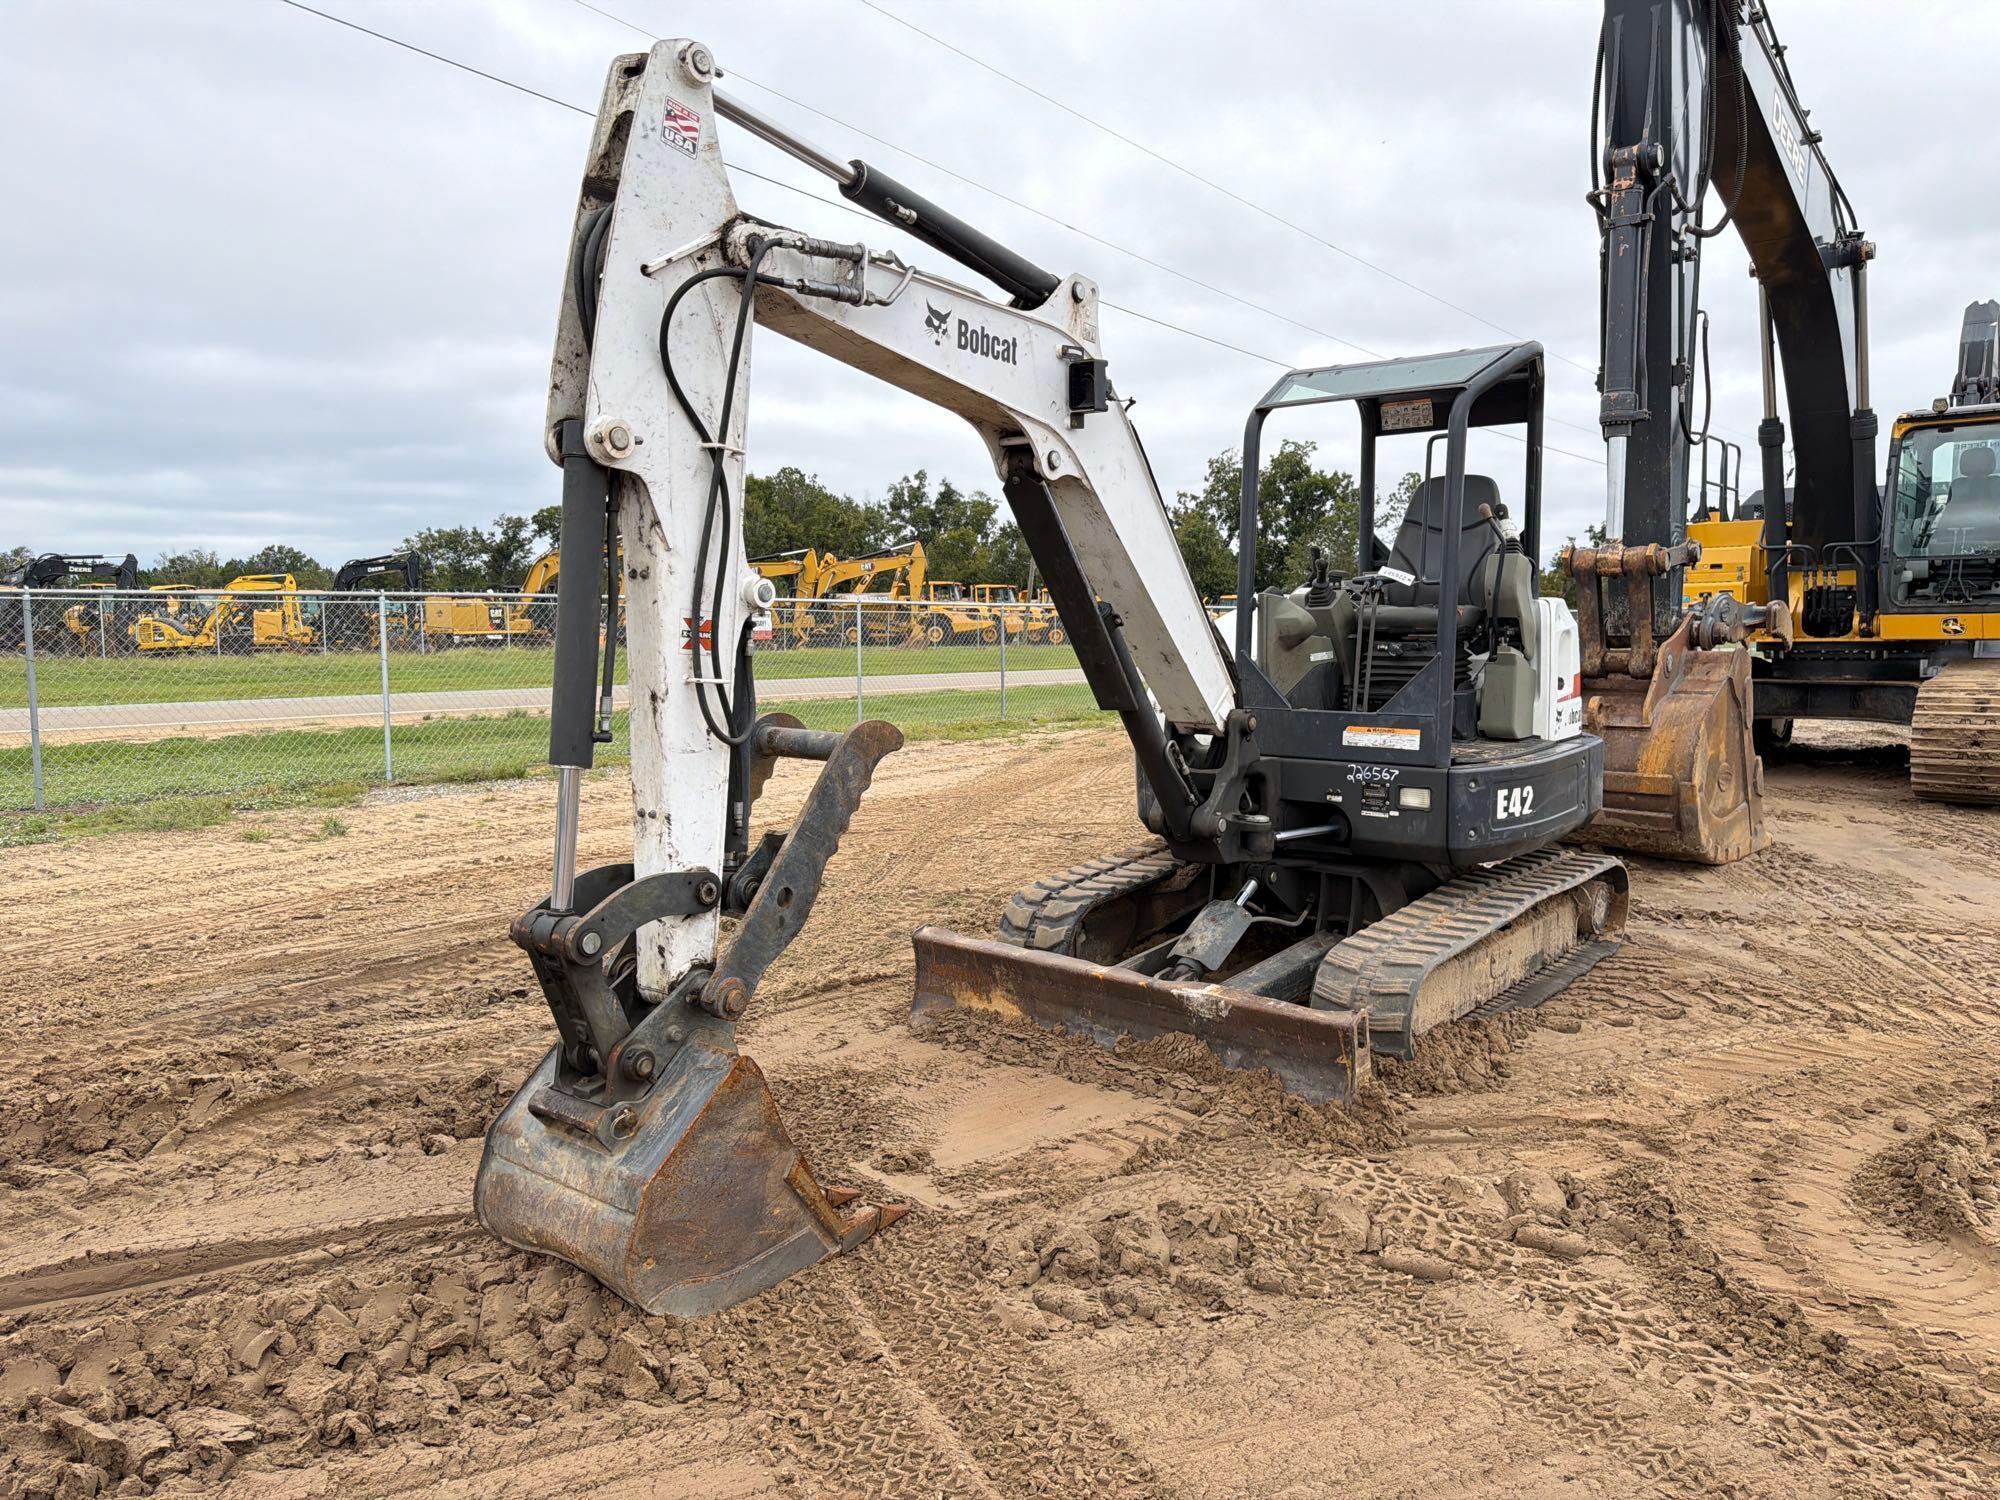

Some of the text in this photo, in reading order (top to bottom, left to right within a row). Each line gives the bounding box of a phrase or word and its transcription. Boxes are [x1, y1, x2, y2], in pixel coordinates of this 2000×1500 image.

[663, 127, 694, 153] USA
[1772, 89, 1805, 188] DEERE
[957, 318, 1018, 366] Bobcat
[68, 565, 93, 573] DEERE
[1346, 763, 1400, 783] 226567
[1496, 785, 1534, 820] E42
